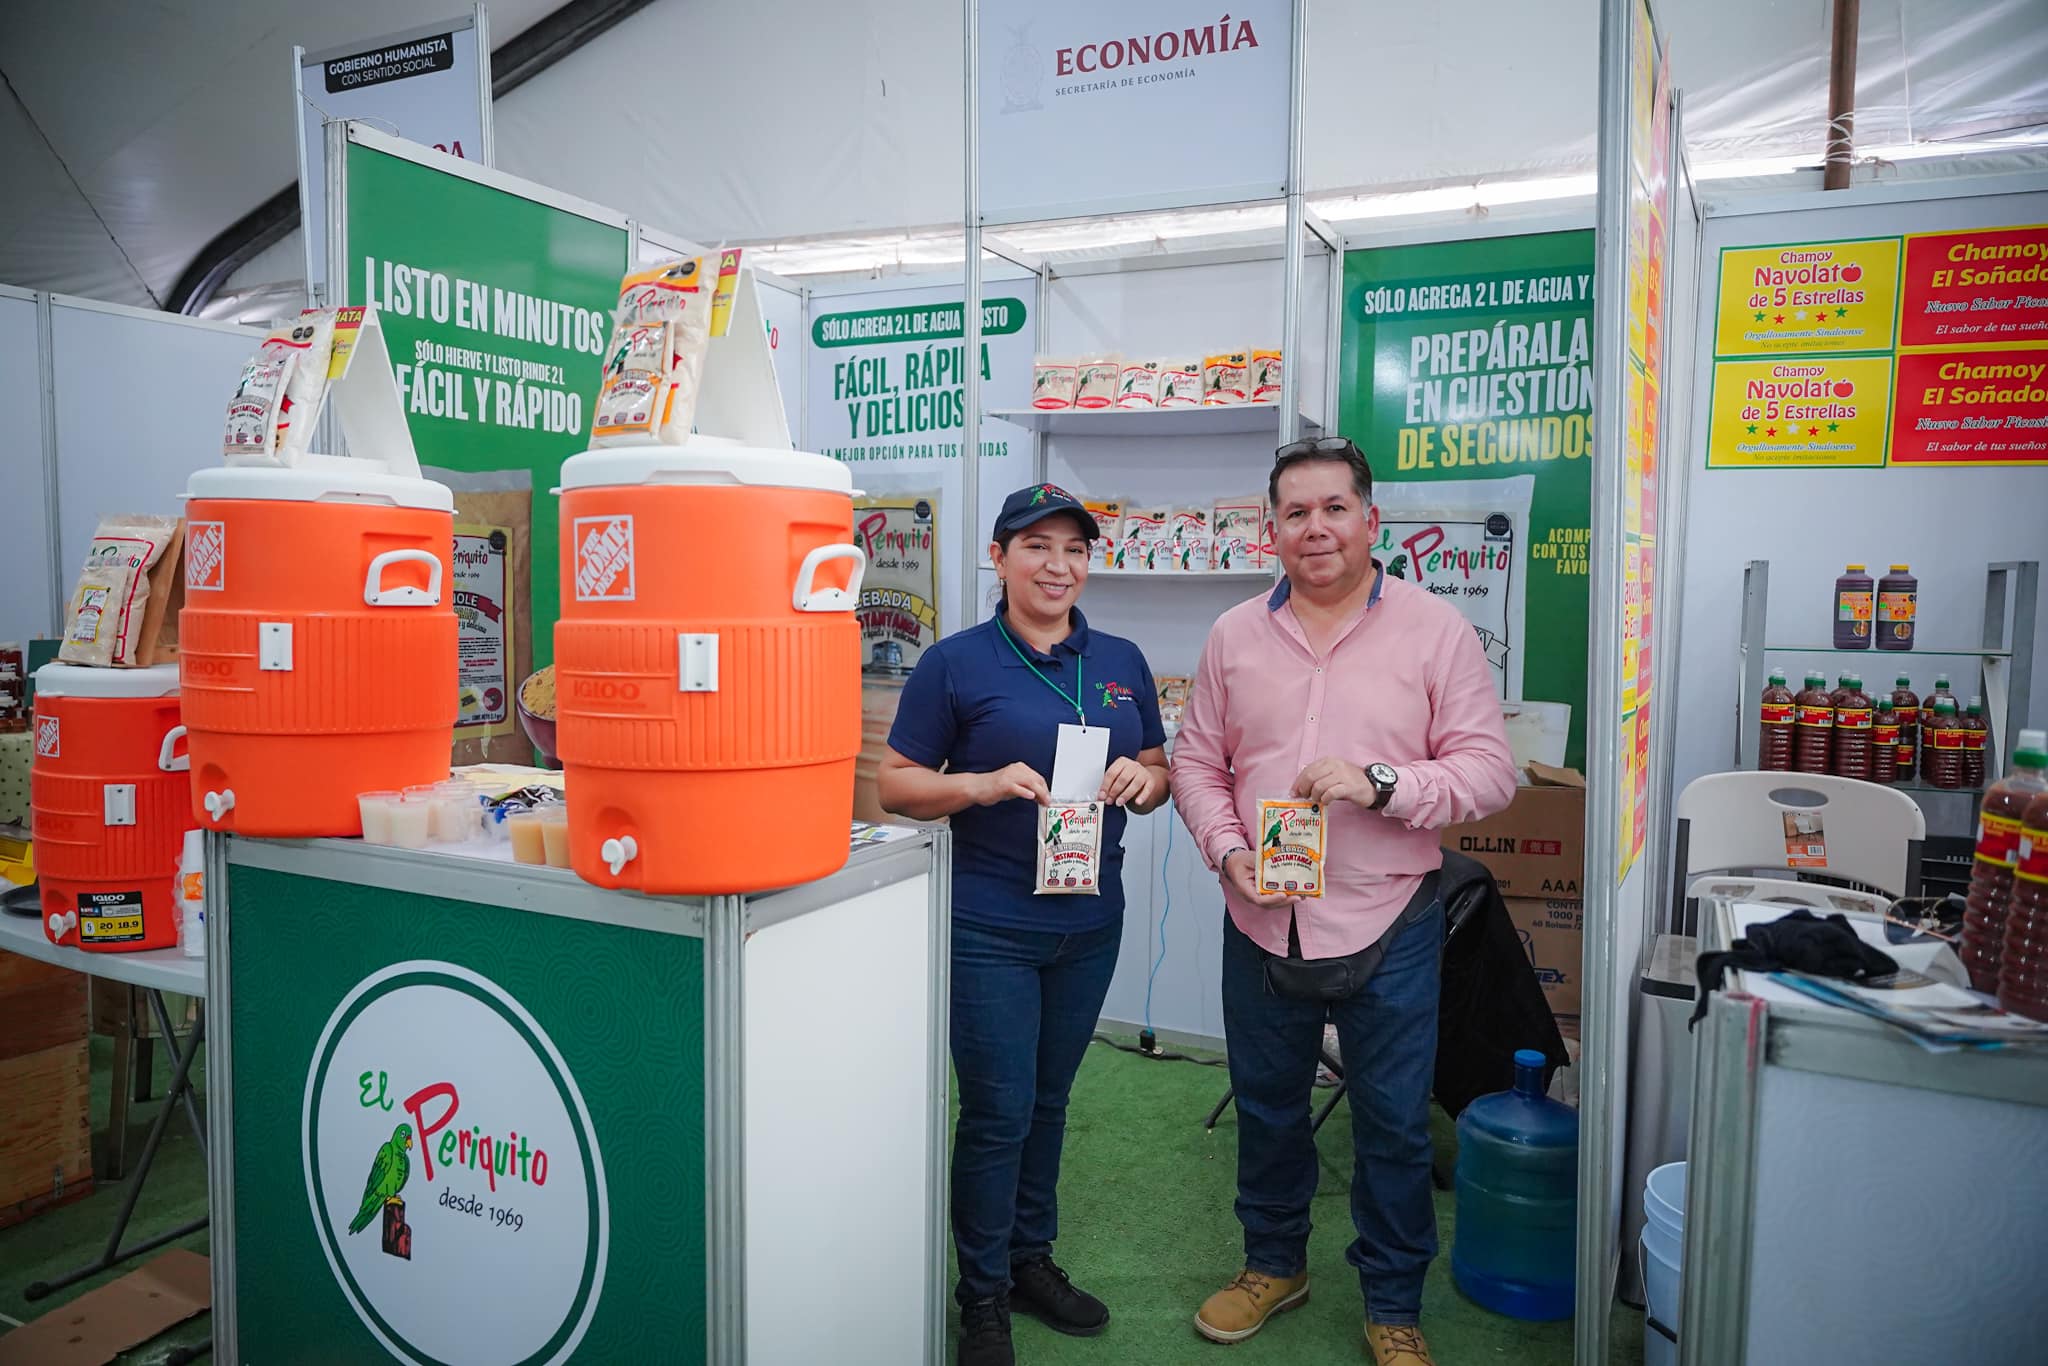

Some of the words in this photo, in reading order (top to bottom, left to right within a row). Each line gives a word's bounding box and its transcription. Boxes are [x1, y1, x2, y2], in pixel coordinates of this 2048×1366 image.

[1056, 13, 1259, 76] ECONOMÍA
[329, 54, 383, 76] GOBIERNO
[384, 39, 448, 61] HUMANISTA
[341, 73, 362, 86] CON
[362, 63, 401, 83] SENTIDO
[402, 57, 436, 73] SOCIAL
[1055, 78, 1118, 97] SECRETARÍA
[1121, 76, 1135, 88] DE
[1137, 67, 1196, 85] ECONOMÍA
[1780, 250, 1833, 264] Chamoy
[1932, 269, 1954, 288] El
[1364, 287, 1406, 315] SÓLO
[1407, 283, 1472, 312] AGREGA
[1475, 281, 1486, 307] 2
[1489, 281, 1498, 306] L
[1502, 279, 1524, 305] DE
[1527, 275, 1573, 304] AGUA
[1578, 274, 1590, 300] Y
[1749, 293, 1768, 308] de
[1773, 287, 1787, 307] 5
[1793, 288, 1865, 306] Estrellas
[1925, 300, 1968, 314] Nuevo
[1970, 296, 2013, 311] Sabor
[366, 256, 449, 324] LISTO
[455, 278, 488, 332] EN
[494, 286, 604, 356] MINUTOS
[822, 318, 849, 342] SÓLO
[850, 315, 893, 338] AGREGA
[895, 315, 903, 335] 2
[905, 313, 911, 334] L
[913, 312, 928, 333] DE
[929, 309, 961, 332] AGUA
[1936, 325, 1949, 335] El
[1950, 324, 1982, 334] sabor
[1984, 322, 1998, 333] de
[2000, 322, 2017, 332] tus
[1410, 318, 1589, 378] PREPÁRALA
[415, 339, 443, 365] SÓLO
[445, 347, 482, 372] HIERVE
[483, 353, 491, 373] Y
[492, 355, 521, 378] LISTO
[522, 360, 551, 383] RINDE
[1773, 365, 1825, 379] Chamoy
[1939, 362, 2046, 382] Chamoy
[834, 355, 900, 400] FÁCIL,
[397, 360, 468, 420] FÁCIL
[474, 376, 490, 423] Y
[496, 376, 581, 436] RÁPIDO
[1406, 379, 1443, 424] EN
[1449, 359, 1594, 422] CUESTIÓN
[1922, 387, 1944, 405] El
[1949, 384, 2048, 404] Soñado
[848, 401, 861, 439] Y
[866, 388, 983, 438] DELICIOS
[1741, 405, 1761, 420] de
[1766, 401, 1779, 420] 5
[1785, 403, 1857, 420] Estrellas
[1915, 417, 1959, 430] Nuevo
[1961, 415, 2003, 430] Sabor
[834, 447, 865, 461] MEJOR
[869, 444, 904, 461] OPCIÓN
[908, 444, 933, 459] PARA
[938, 443, 957, 458] TUS
[1397, 426, 1436, 471] DE
[1926, 441, 1939, 451] El
[1940, 442, 1973, 451] sabor
[1974, 440, 1988, 451] de
[1990, 441, 2007, 450] tus
[2009, 440, 2047, 450] sueños
[581, 527, 600, 558] THE
[858, 512, 932, 560] Periquito
[188, 527, 222, 585] HOME
[577, 521, 628, 597] HOME
[1402, 526, 1508, 582] Periquito
[1532, 544, 1557, 559] CON
[1561, 544, 1586, 559] TUS
[197, 547, 222, 586] DEPOT
[595, 548, 629, 597] DEPOT
[876, 557, 900, 569] desde
[901, 560, 920, 571] 1969
[1556, 559, 1591, 575] FAVO
[1426, 582, 1459, 596] desde
[1463, 583, 1489, 598] 1969
[574, 680, 640, 700] IGLOO
[1061, 809, 1097, 829] Periquito
[1266, 809, 1277, 820] El
[1280, 810, 1320, 831] Periquito
[1460, 837, 1516, 854] OLLIN
[1541, 879, 1578, 894] AAA
[92, 894, 125, 903] IGLOO
[87, 922, 92, 932] 5
[100, 922, 113, 930] 20
[118, 920, 139, 929] 18.9
[1549, 911, 1573, 921] 1000
[359, 1070, 394, 1112] El
[403, 1082, 548, 1193] Periquito
[439, 1187, 483, 1217] desde
[488, 1206, 524, 1233] 1969
